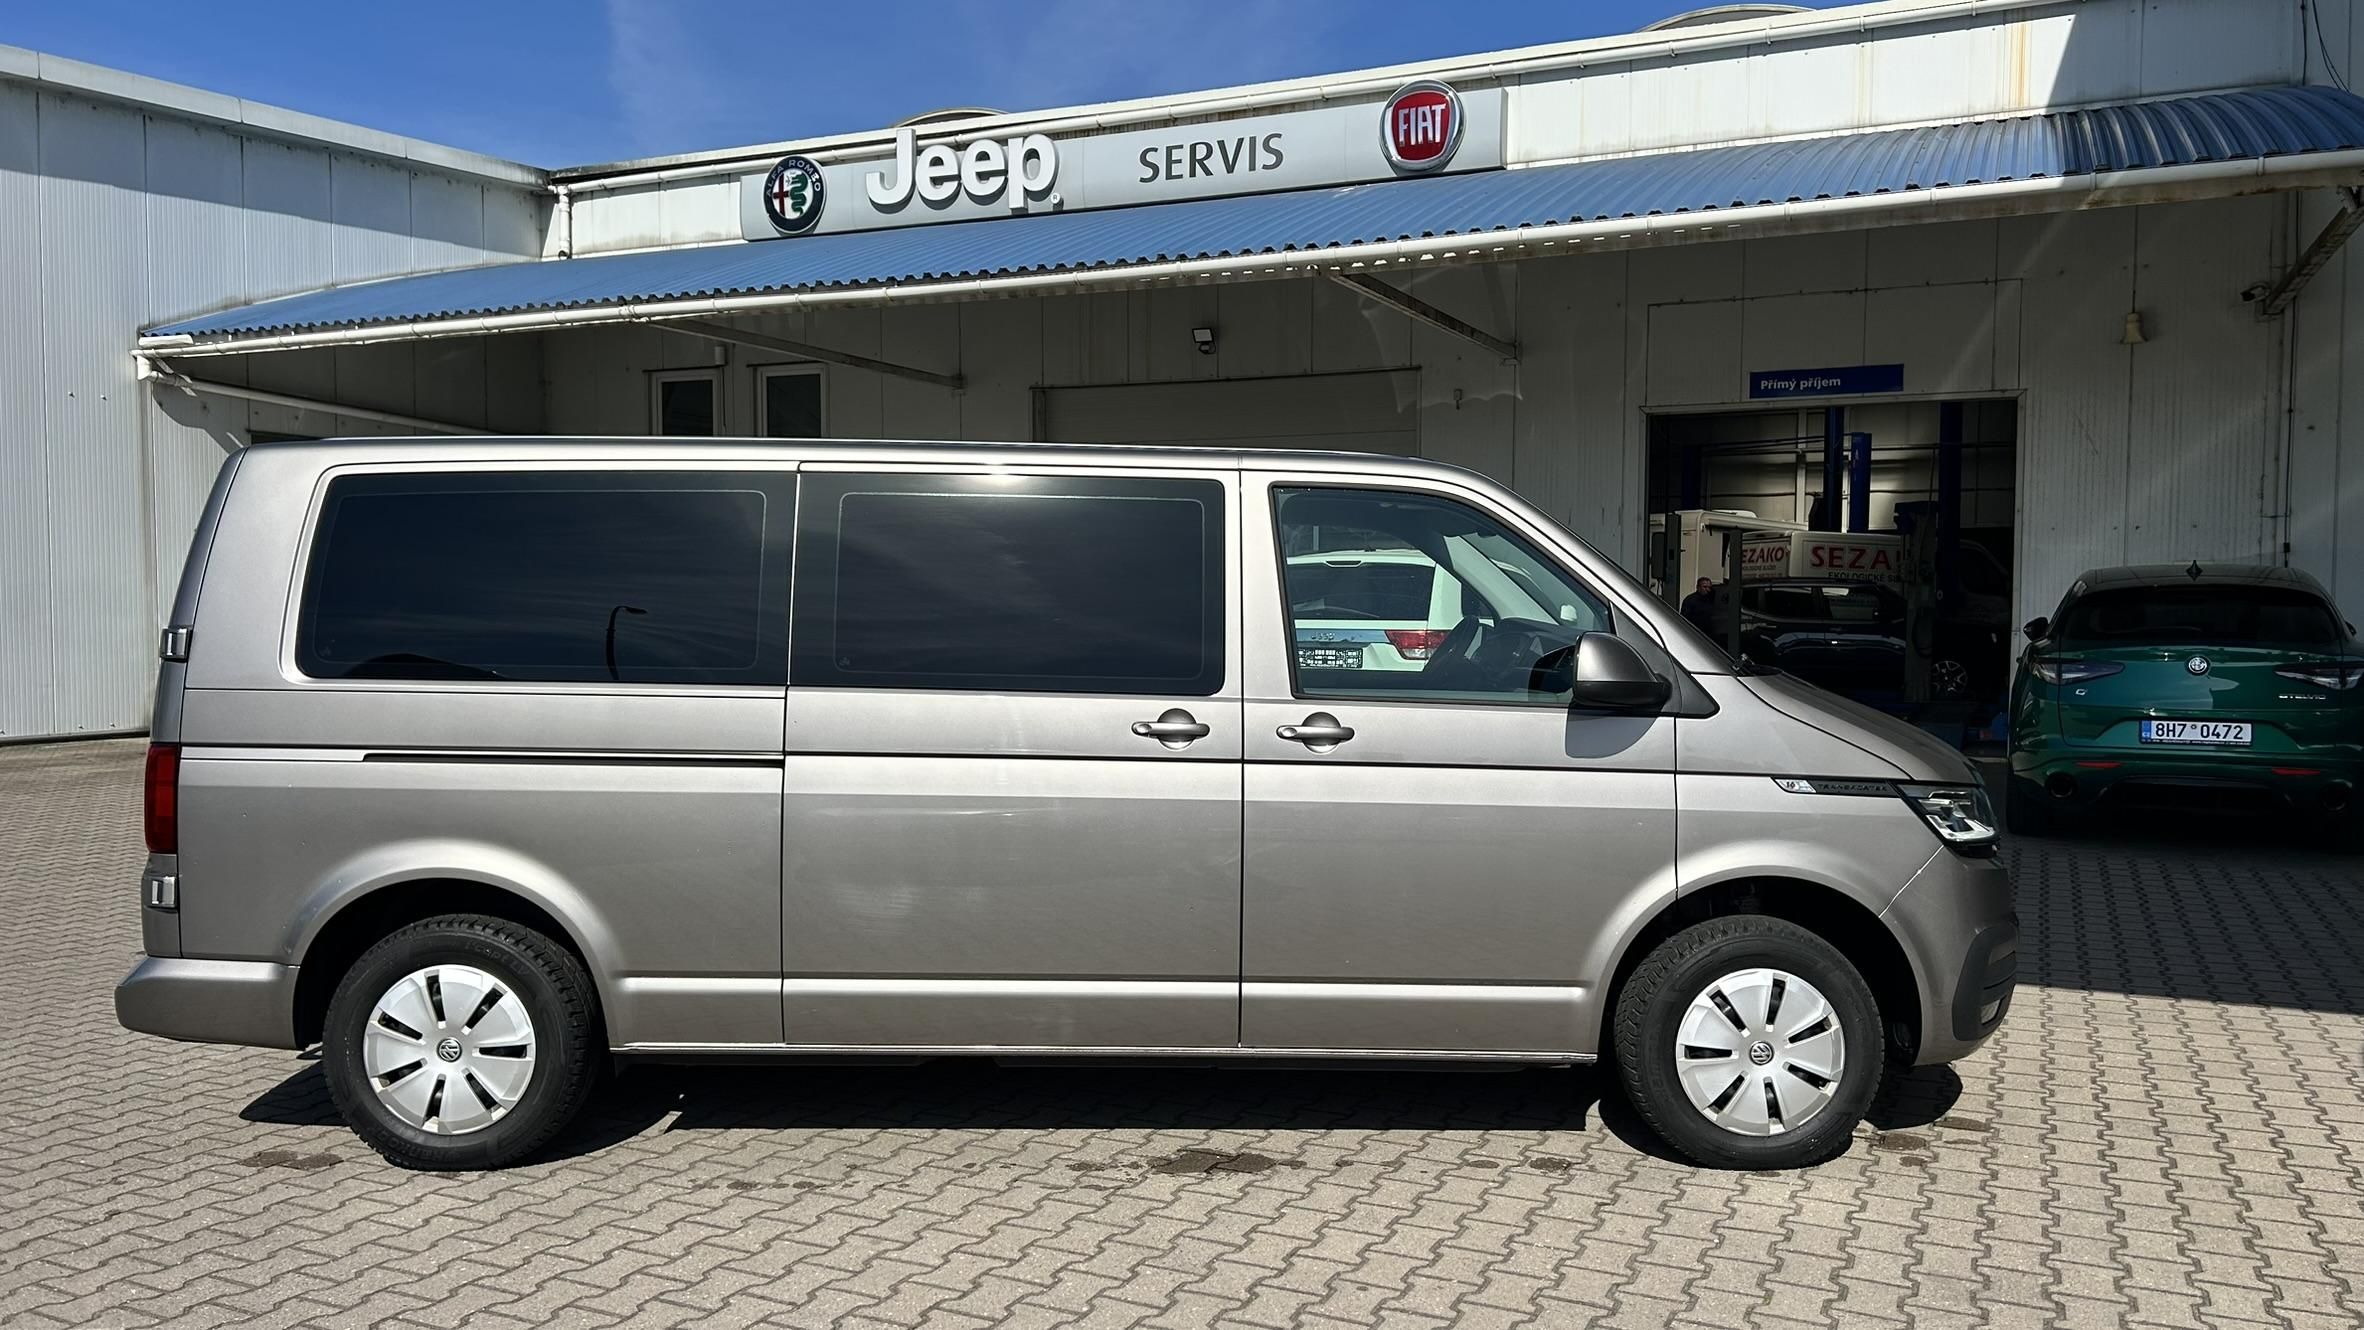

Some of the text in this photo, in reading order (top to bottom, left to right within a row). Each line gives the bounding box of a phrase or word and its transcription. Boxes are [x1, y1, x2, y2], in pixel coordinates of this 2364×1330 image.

[1398, 103, 1447, 147] FIAT
[866, 128, 1057, 208] Jeep
[1138, 132, 1284, 183] SERVIS
[766, 159, 821, 198] ALFA ROMEO
[1760, 376, 1841, 391] Přímý příjem
[1742, 547, 1785, 563] EZAKO
[1811, 545, 1900, 570] SEZA
[2155, 722, 2187, 738] 8H7
[2200, 723, 2244, 740] 0472
